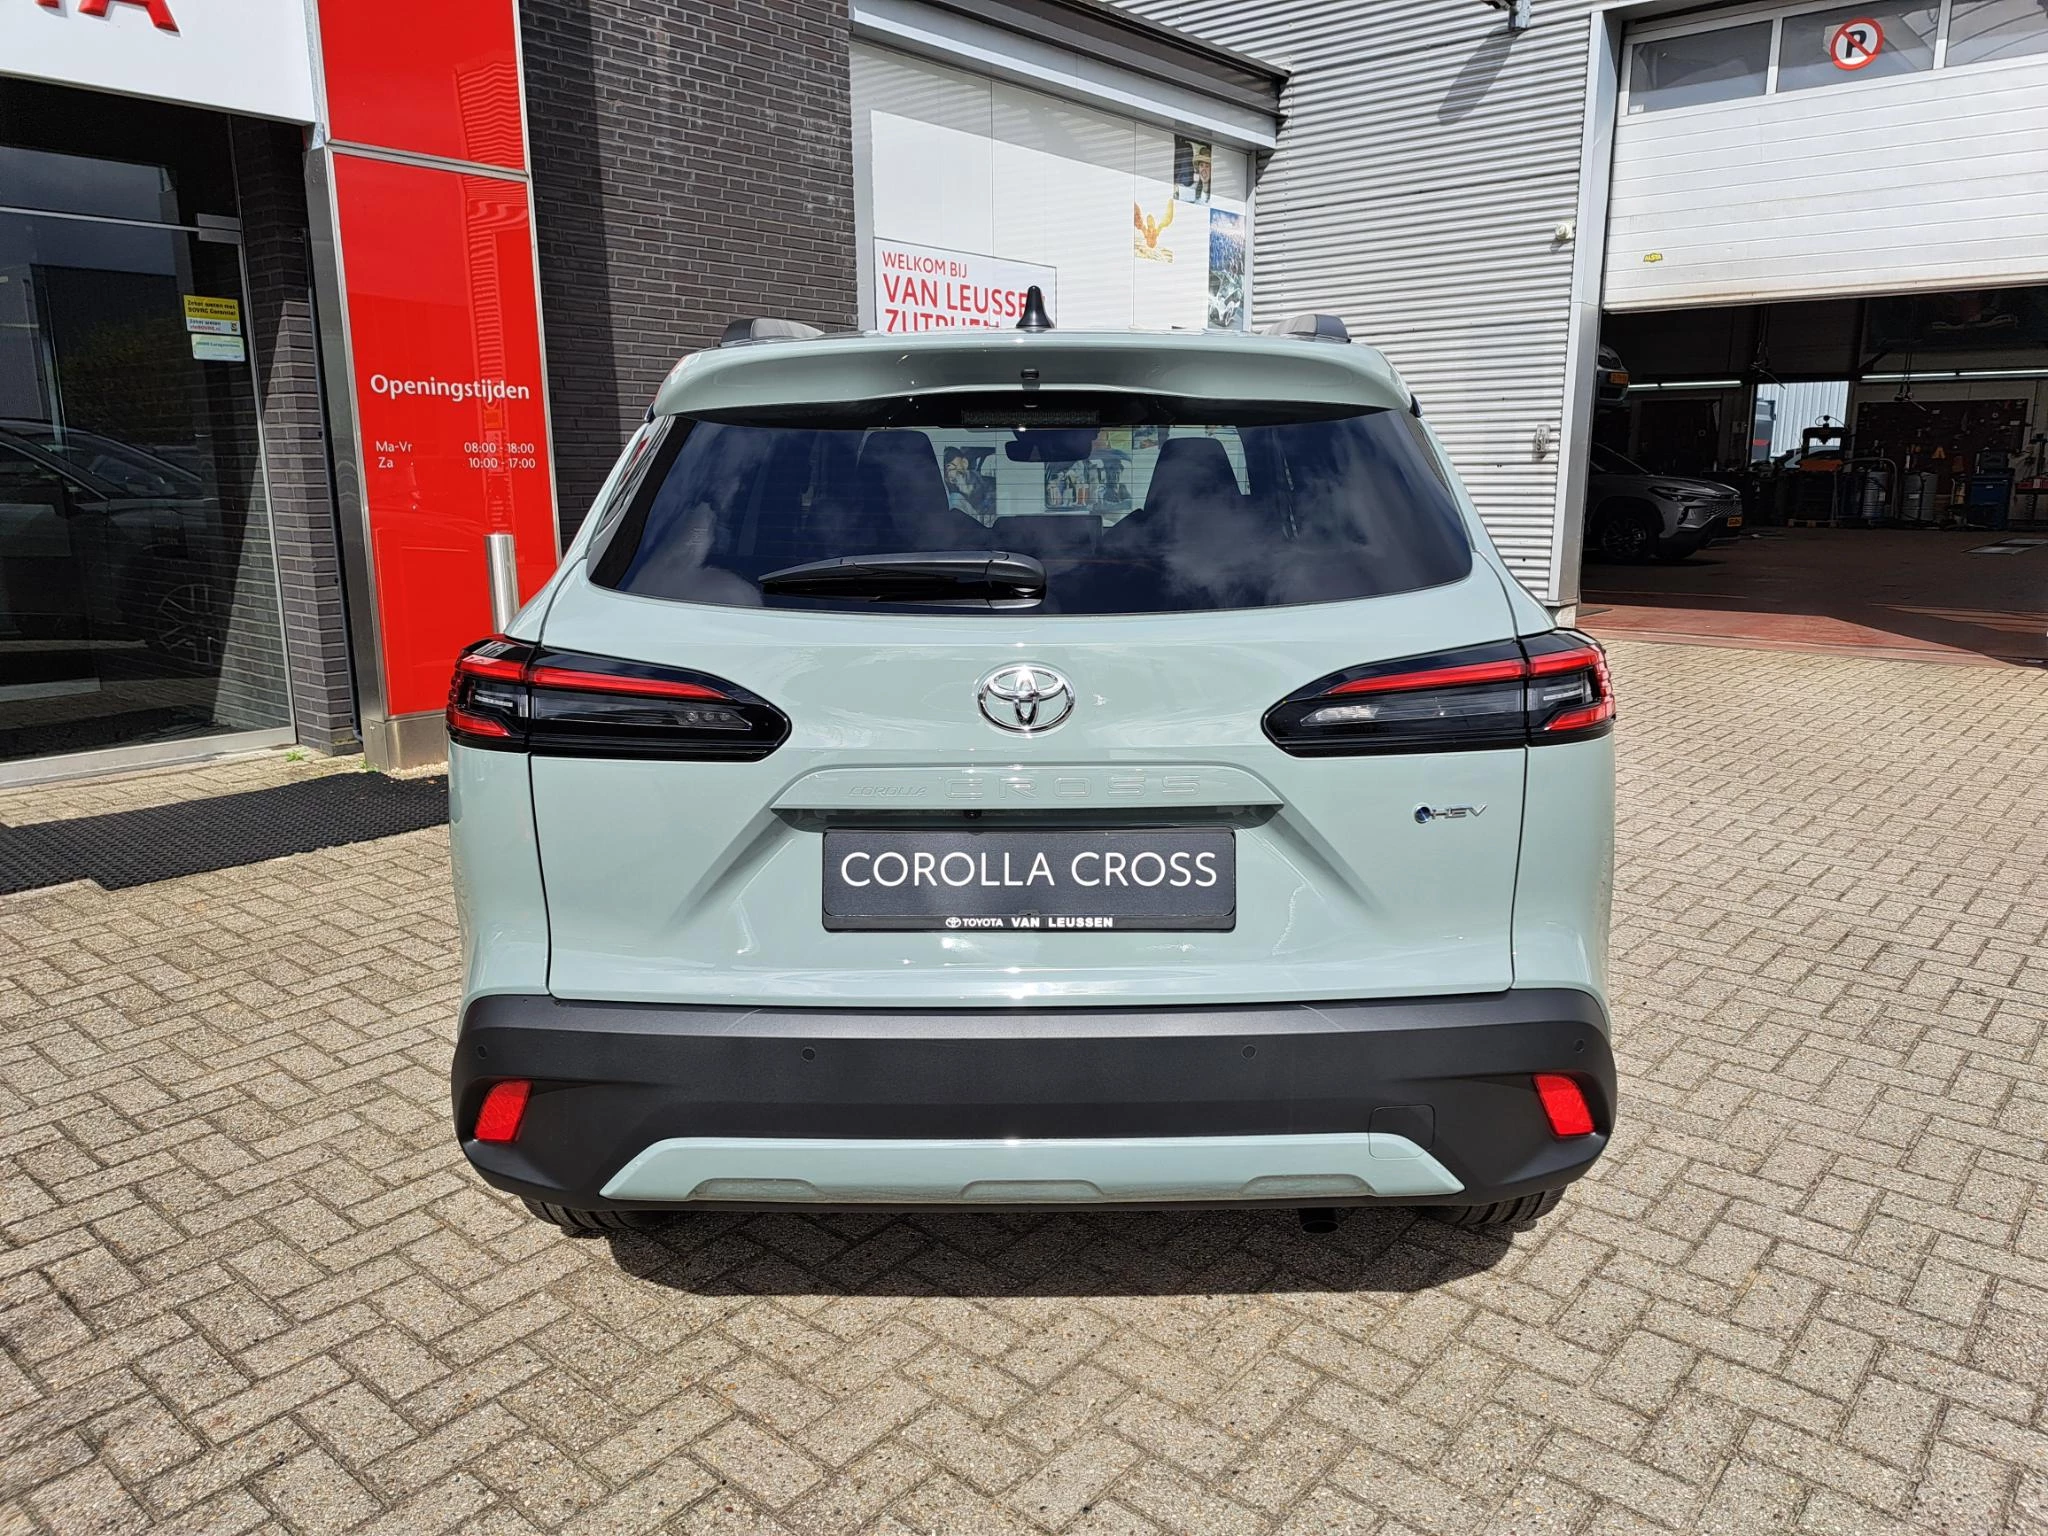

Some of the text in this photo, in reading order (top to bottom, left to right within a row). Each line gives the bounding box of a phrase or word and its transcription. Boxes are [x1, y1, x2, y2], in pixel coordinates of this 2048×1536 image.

[882, 251, 968, 279] WELKOM BIJ
[883, 273, 1045, 318] VAN LEUSSE
[370, 374, 530, 403] Openingstijden
[375, 441, 413, 452] Ma-Vr
[464, 443, 497, 454] 08:00
[507, 443, 535, 454] 18:00
[378, 457, 394, 468] Za
[469, 458, 498, 469] 10:00
[508, 458, 536, 469] 17:00
[850, 774, 1201, 801] COROLLA CROSS
[841, 852, 1217, 887] COROLLA CROSS
[963, 917, 1113, 928] TOYOTA VAN LEUSSEN
